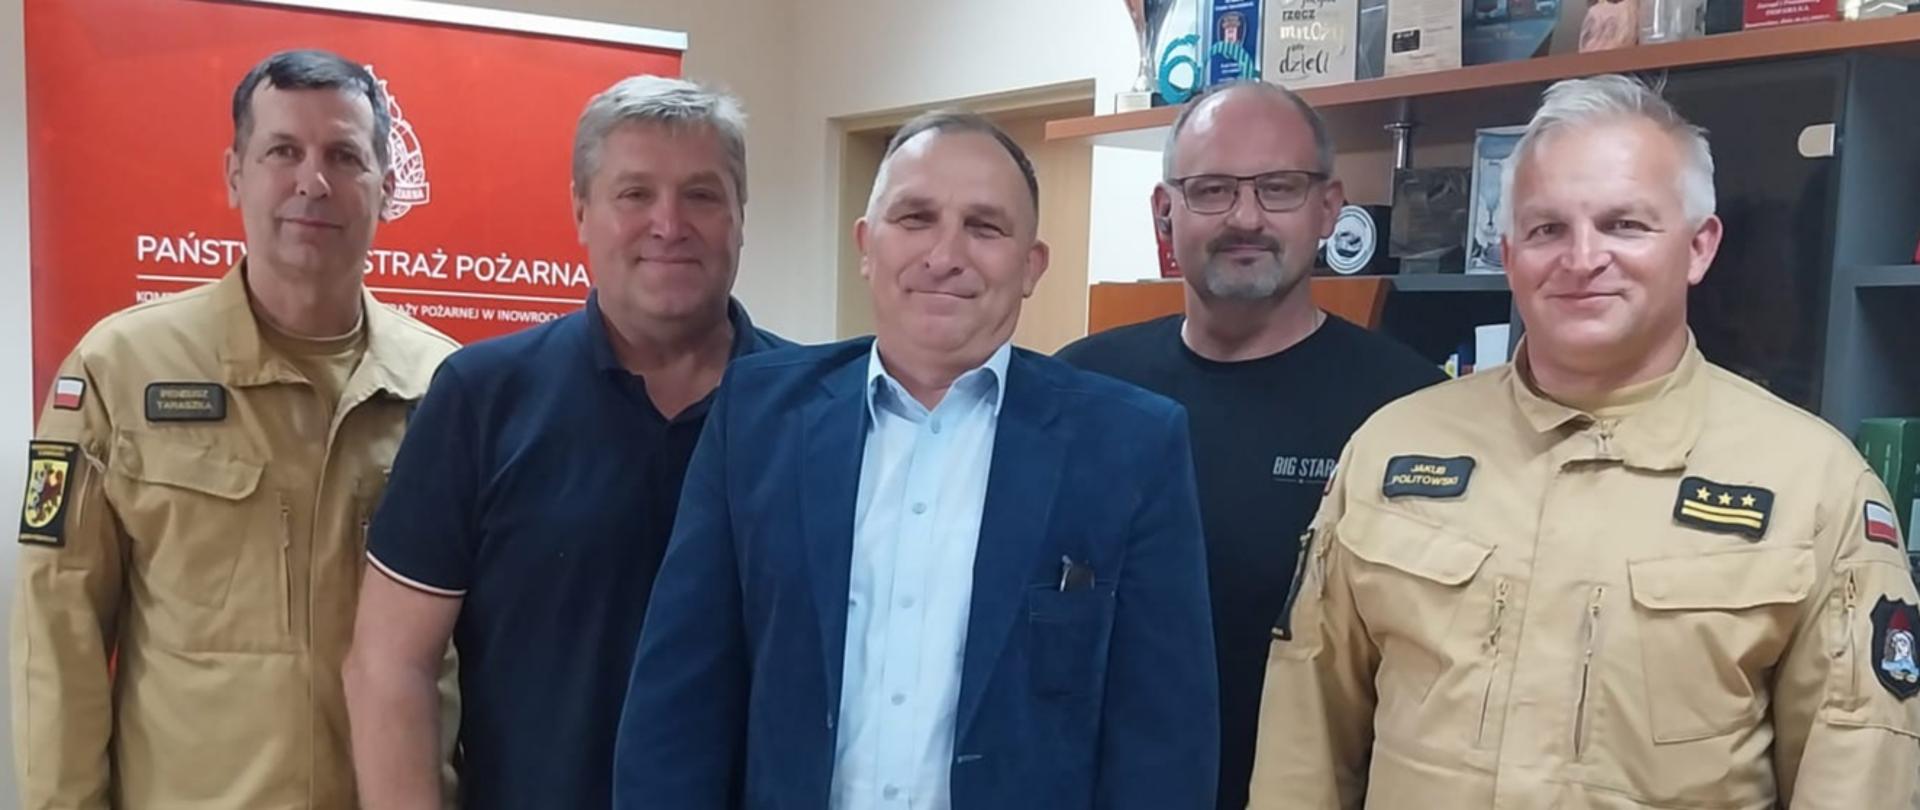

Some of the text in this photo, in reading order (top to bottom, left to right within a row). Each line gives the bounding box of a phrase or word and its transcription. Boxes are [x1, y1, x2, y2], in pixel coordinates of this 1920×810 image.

[1282, 9, 1316, 21] rzecz
[455, 252, 591, 288] POŻARNA
[420, 303, 479, 319] POŻARNEJ
[481, 308, 495, 319] W
[1272, 456, 1336, 478] BIG STAR
[1410, 463, 1447, 475] JAKUB
[1391, 474, 1460, 487] POLITOWSKI
